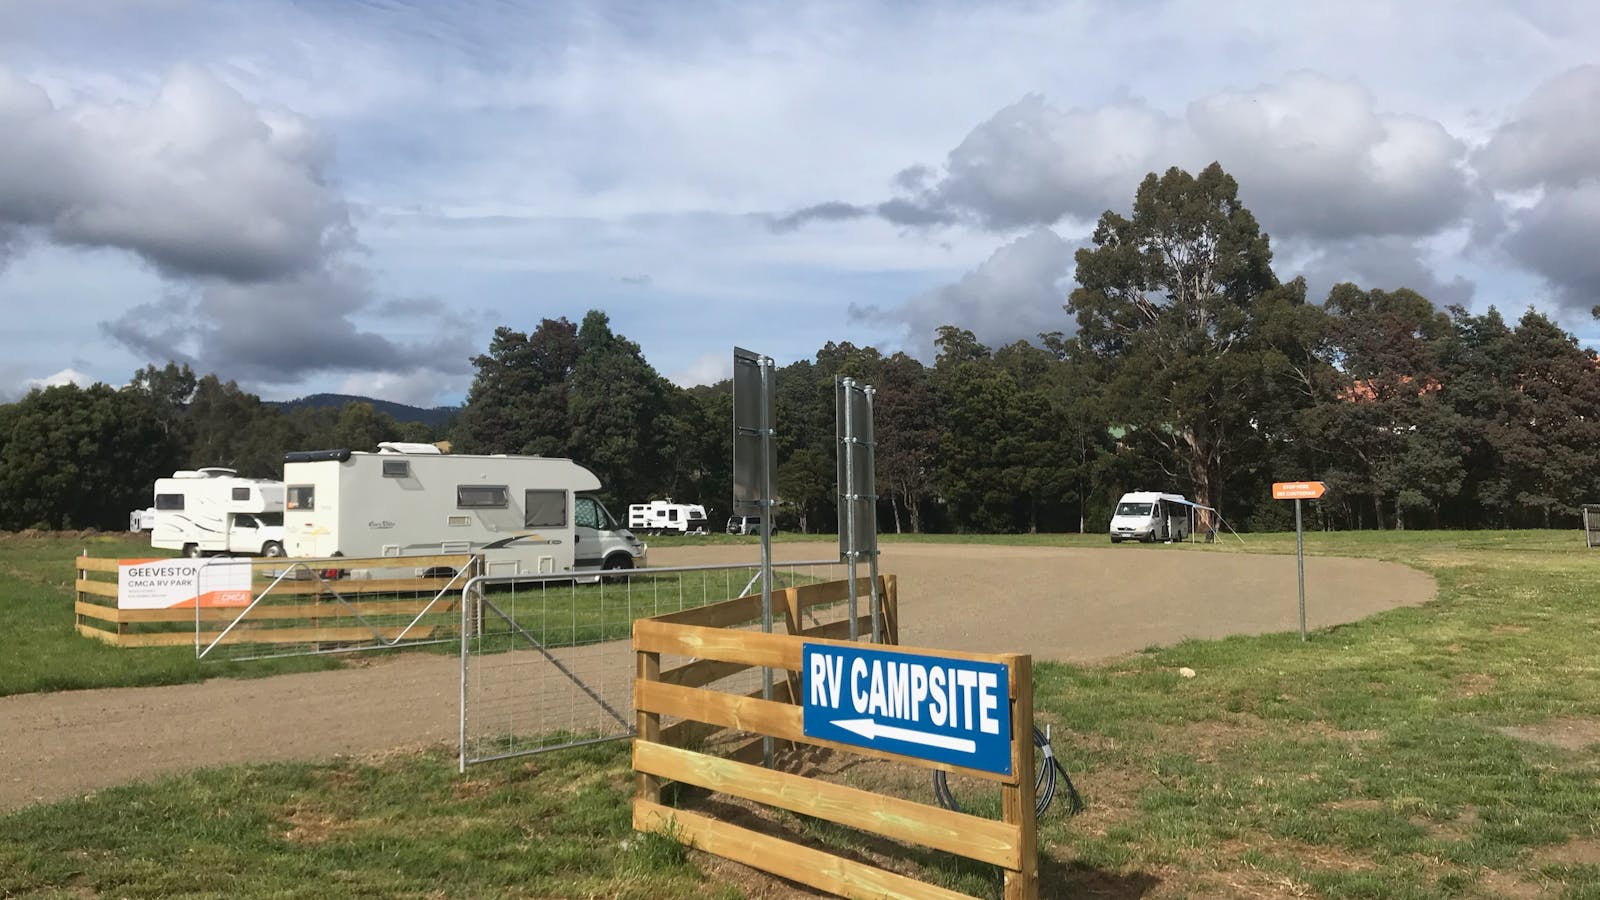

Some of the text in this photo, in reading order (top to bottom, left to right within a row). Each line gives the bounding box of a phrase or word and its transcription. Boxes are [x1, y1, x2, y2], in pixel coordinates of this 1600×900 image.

[128, 567, 197, 577] GEEVESTON
[810, 652, 1000, 735] RV CAMPSITE
